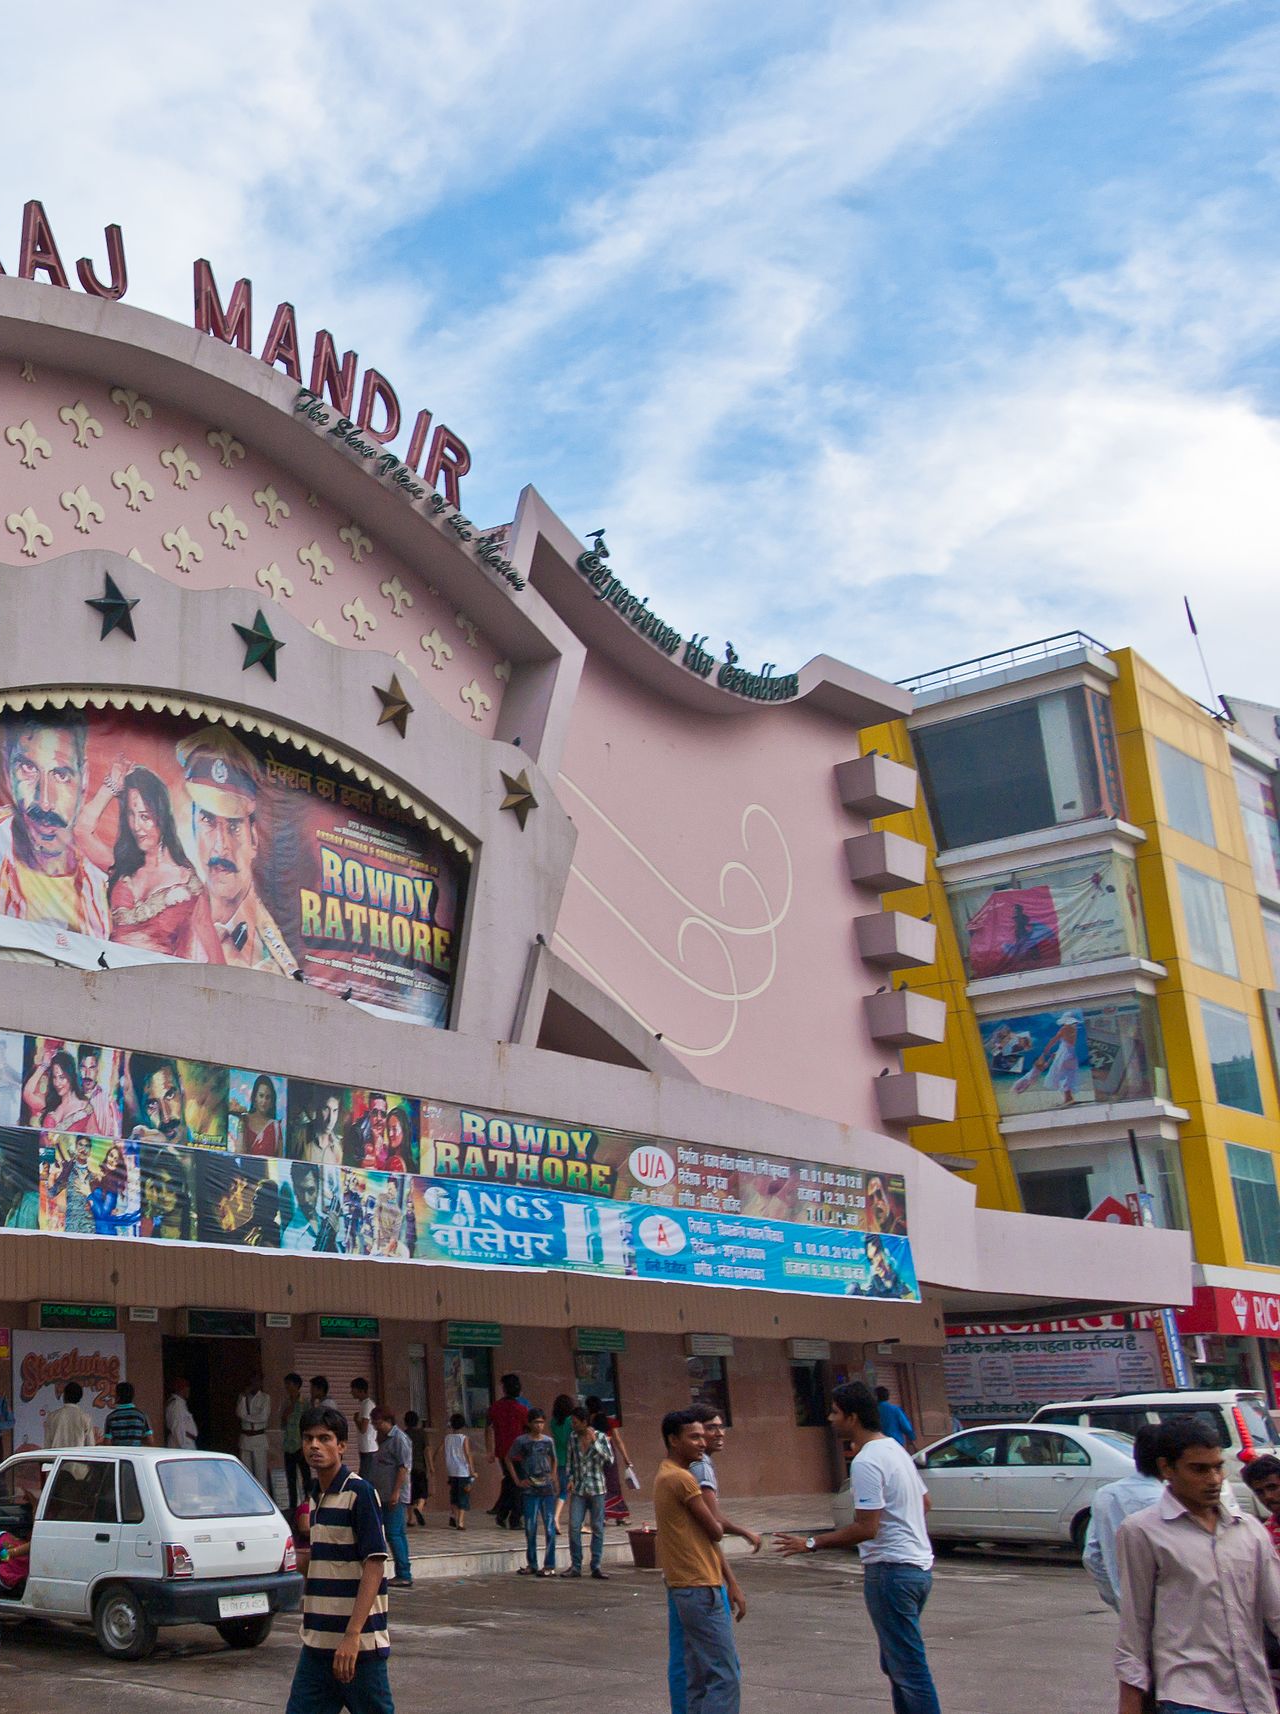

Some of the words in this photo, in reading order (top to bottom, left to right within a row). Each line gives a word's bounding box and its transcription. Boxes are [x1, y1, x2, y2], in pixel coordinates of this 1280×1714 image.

[193, 257, 471, 511] MANDIR
[295, 387, 329, 426] The
[319, 846, 435, 922] ROWDY
[299, 886, 452, 970] RATHORE
[460, 1110, 593, 1160] ROWDY
[434, 1140, 612, 1194] RATHORE
[637, 1152, 667, 1180] U/A
[423, 1186, 554, 1222] GANGS
[429, 1219, 553, 1260] वासेपुर
[657, 1223, 670, 1248] A
[1253, 1296, 1280, 1331] RIC
